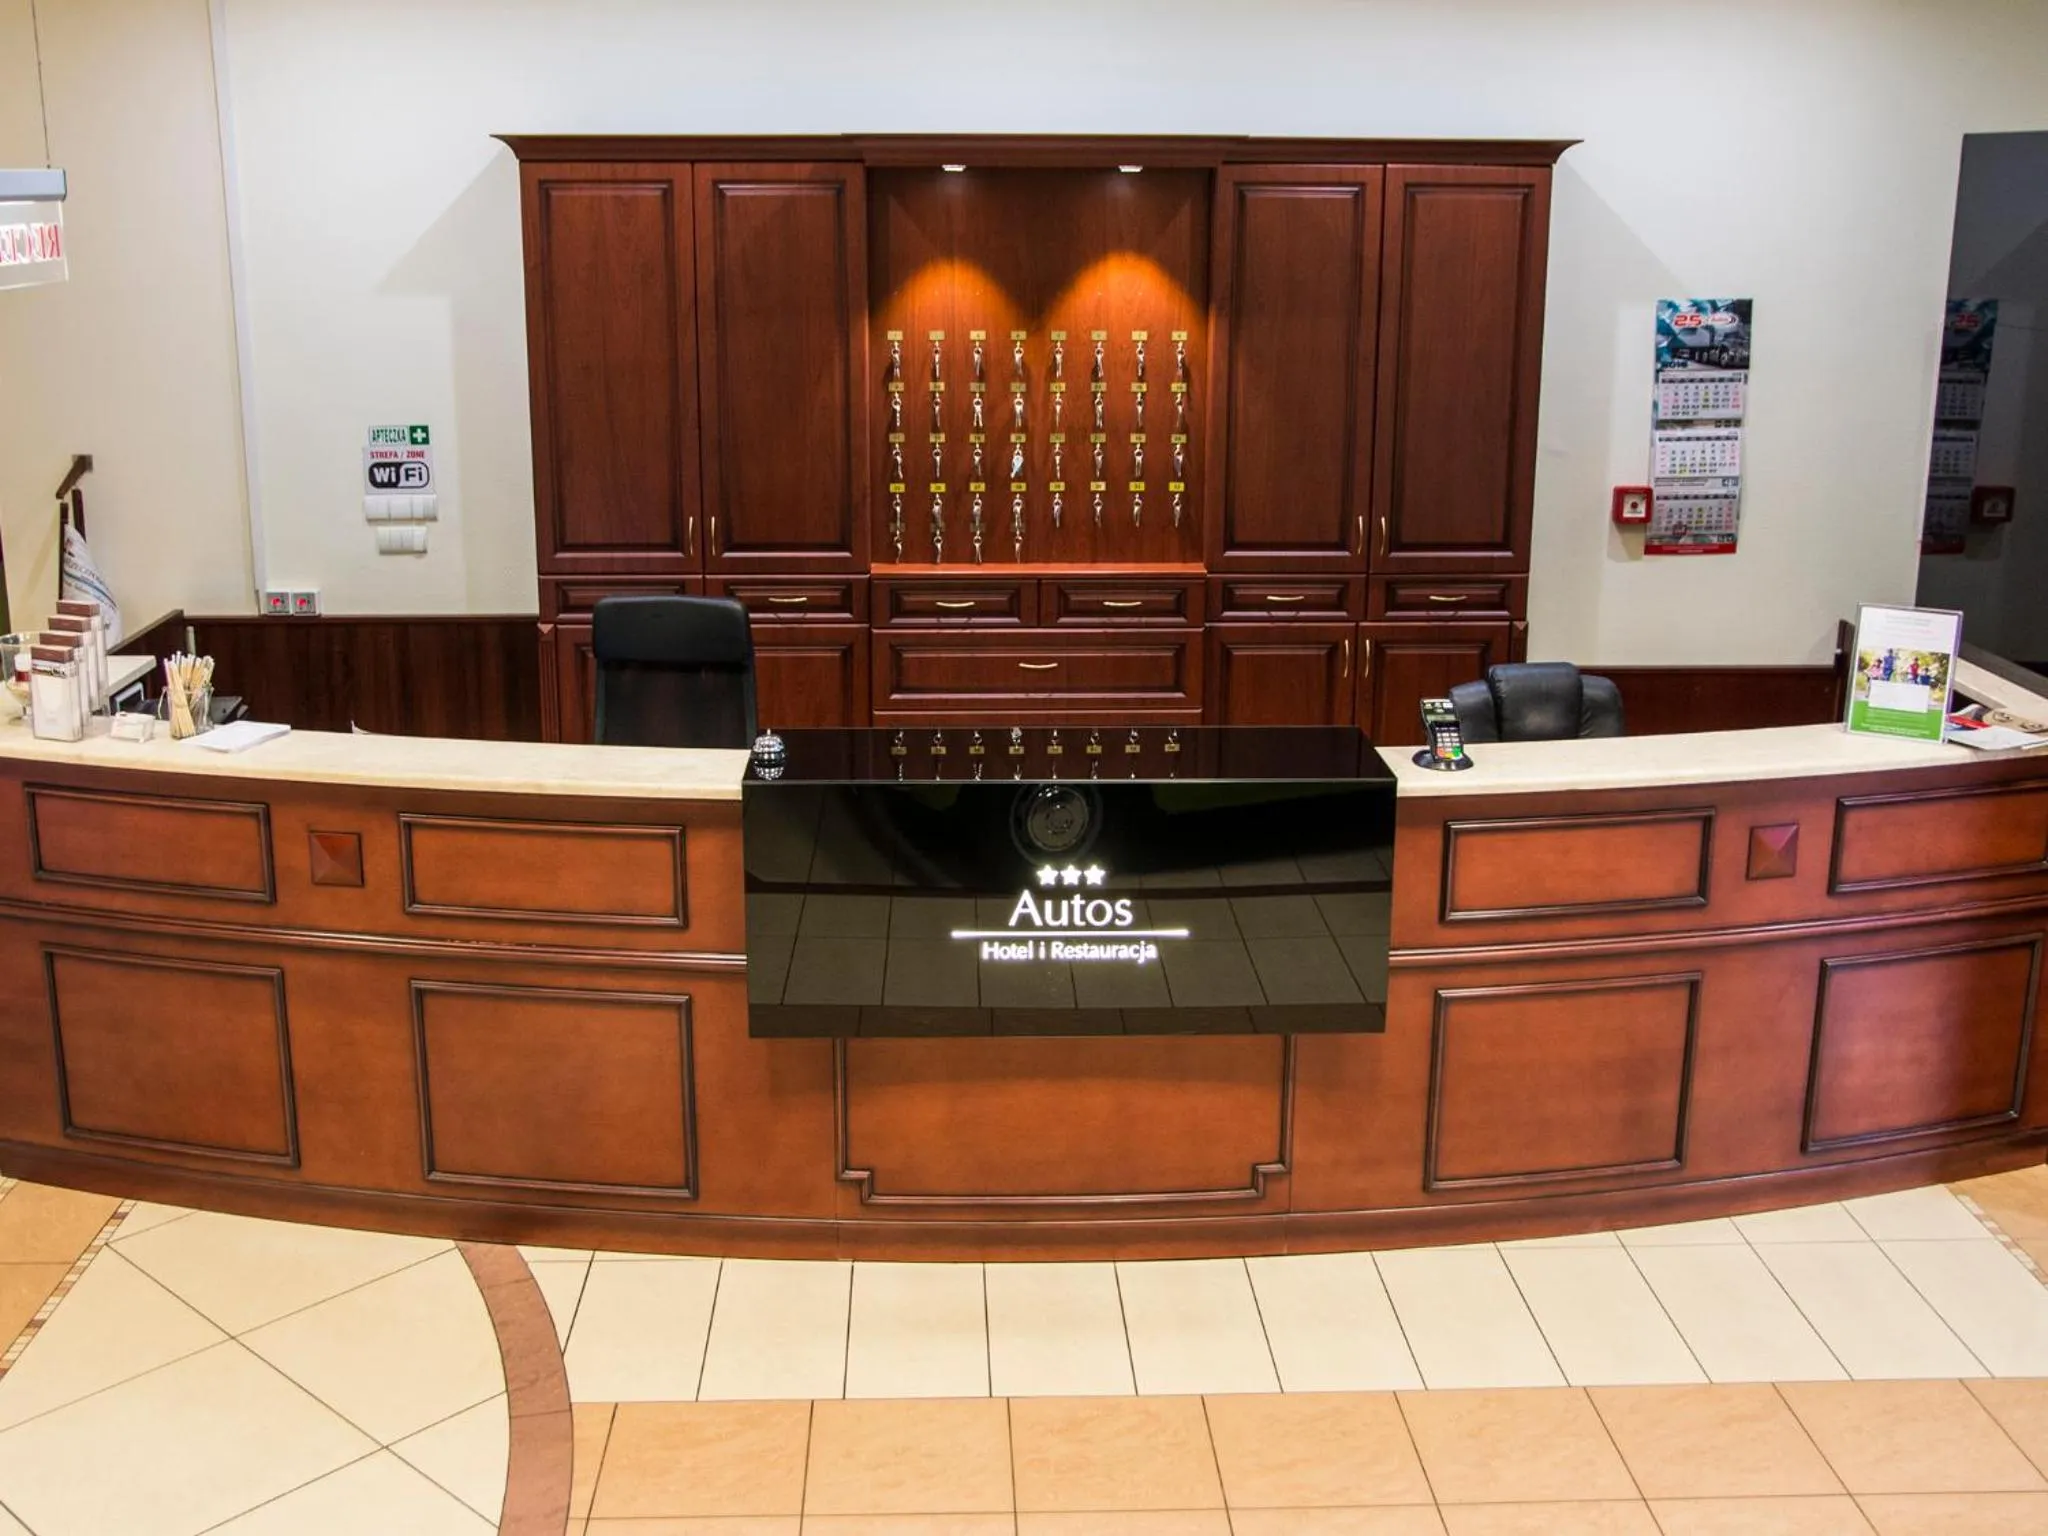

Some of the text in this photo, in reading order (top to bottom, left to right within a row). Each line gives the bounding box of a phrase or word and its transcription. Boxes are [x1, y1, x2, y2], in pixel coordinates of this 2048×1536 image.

[1674, 314, 1703, 327] 25
[372, 428, 406, 443] APTECZKA
[370, 450, 399, 459] STREFA
[406, 450, 425, 459] ZONE
[1008, 889, 1134, 927] Autos
[981, 940, 1158, 964] Hotel i Restauracja
